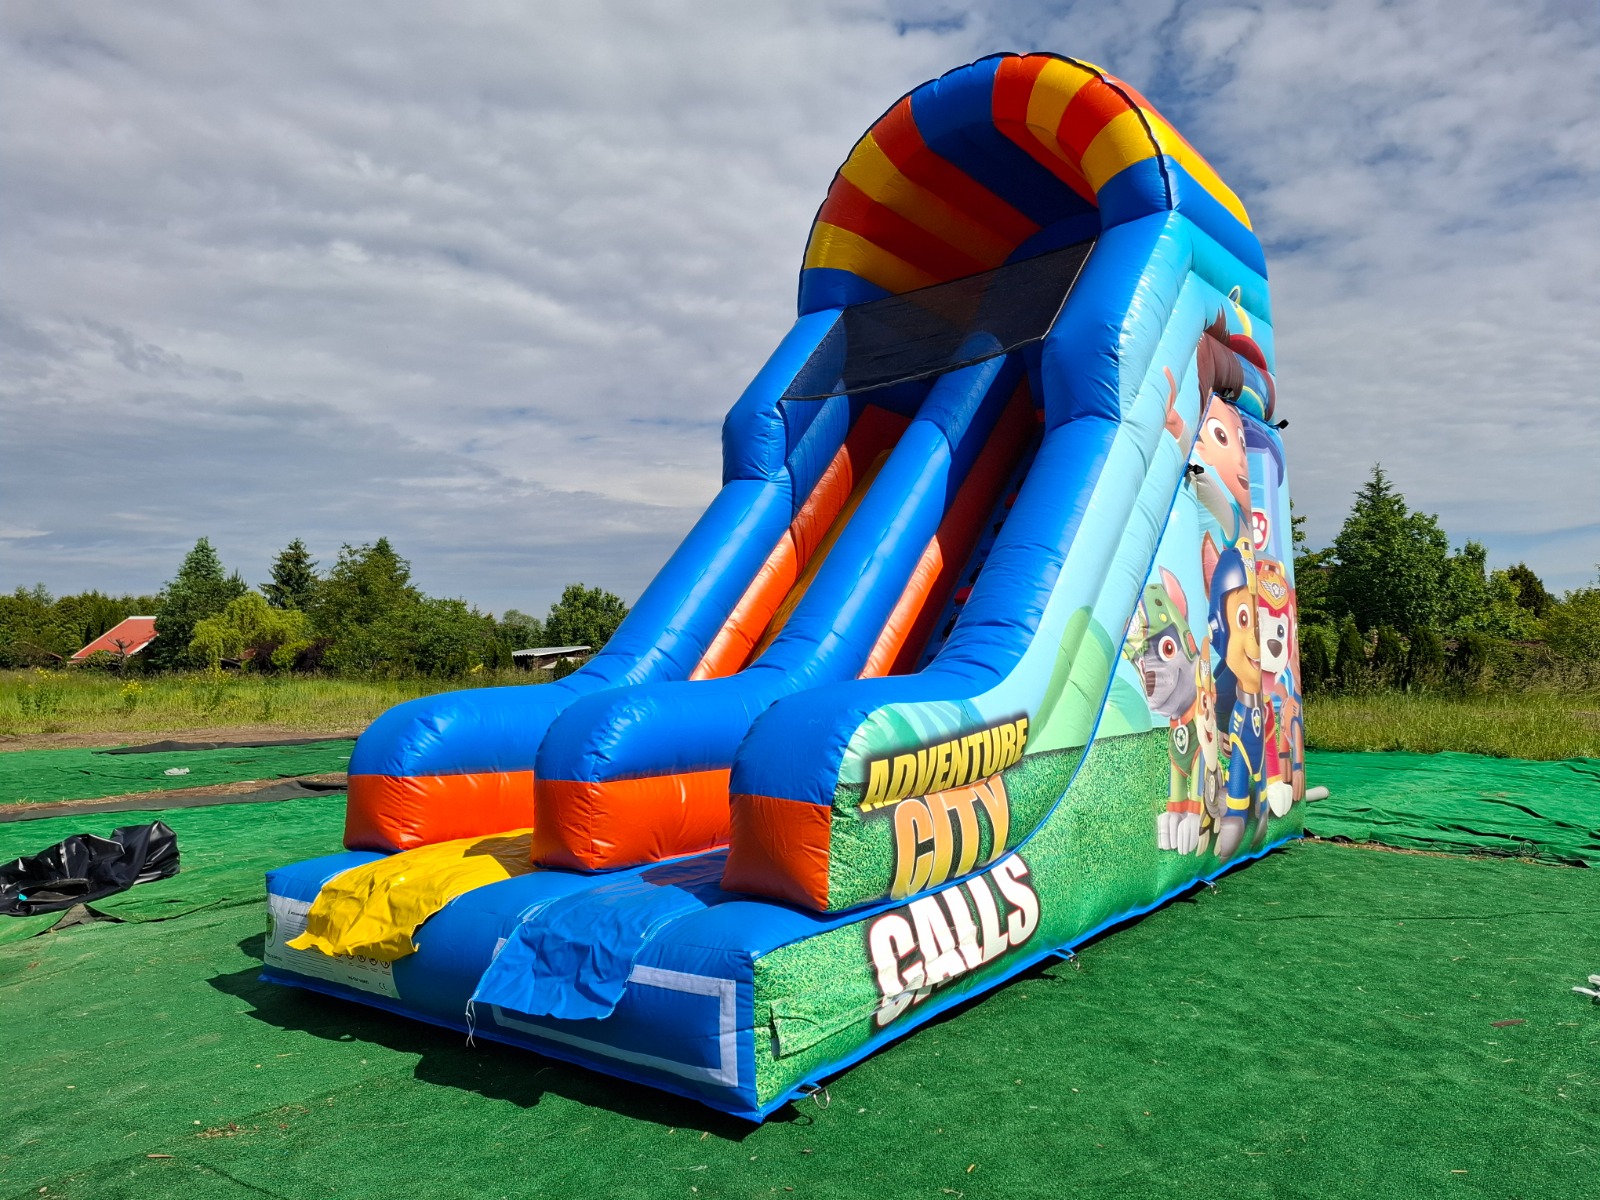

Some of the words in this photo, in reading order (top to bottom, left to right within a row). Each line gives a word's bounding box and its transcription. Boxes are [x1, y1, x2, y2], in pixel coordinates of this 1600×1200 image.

[859, 718, 1029, 813] ADVENTURE
[890, 774, 1010, 901] CITY
[868, 853, 1040, 1027] CALLS
